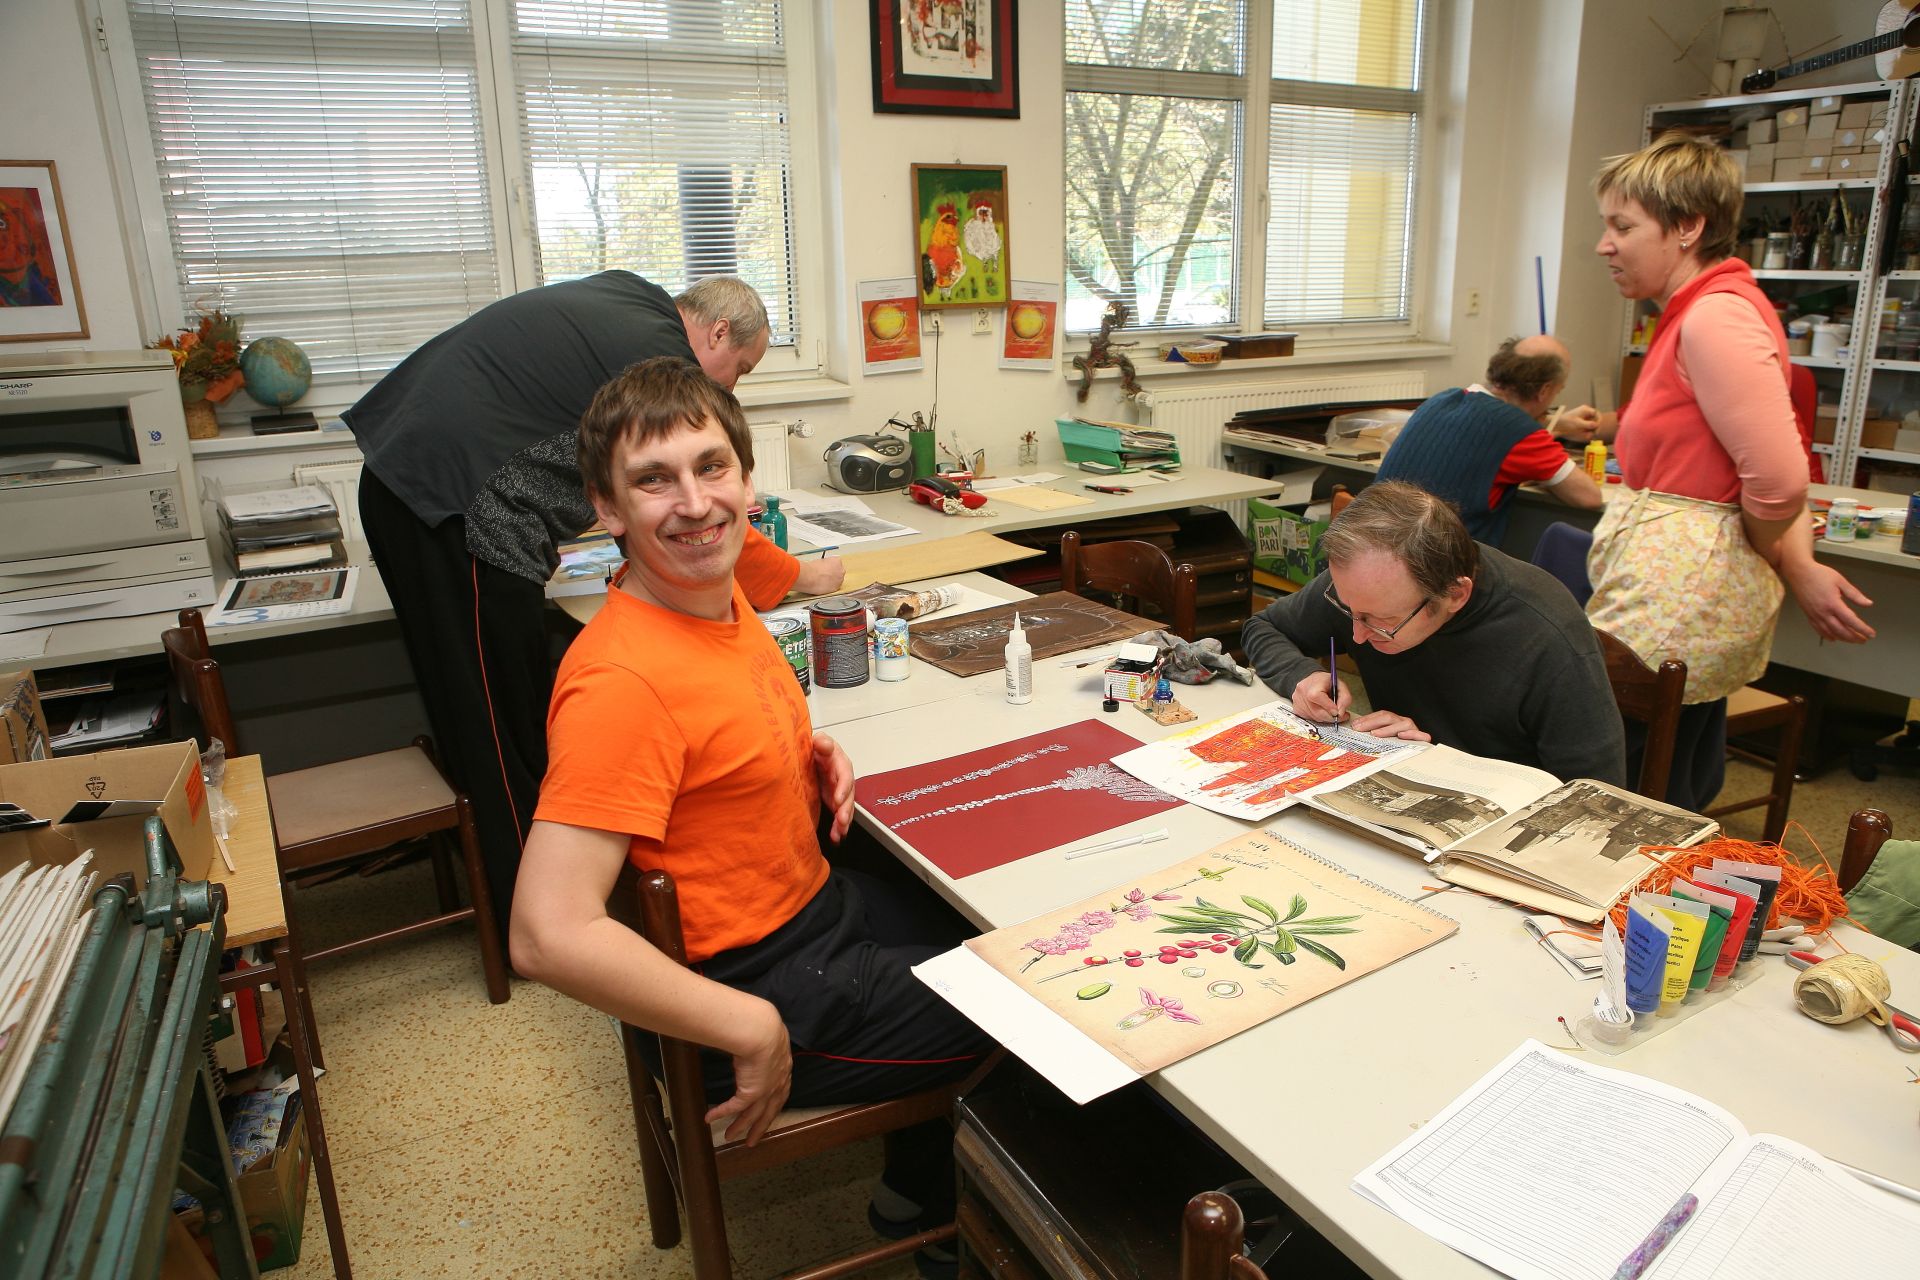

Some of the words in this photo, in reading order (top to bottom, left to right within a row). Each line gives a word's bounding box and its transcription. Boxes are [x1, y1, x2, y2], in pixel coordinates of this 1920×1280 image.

[0, 382, 33, 390] SHARP
[1258, 525, 1279, 538] BON
[1259, 539, 1280, 552] PARI
[216, 608, 269, 626] 3
